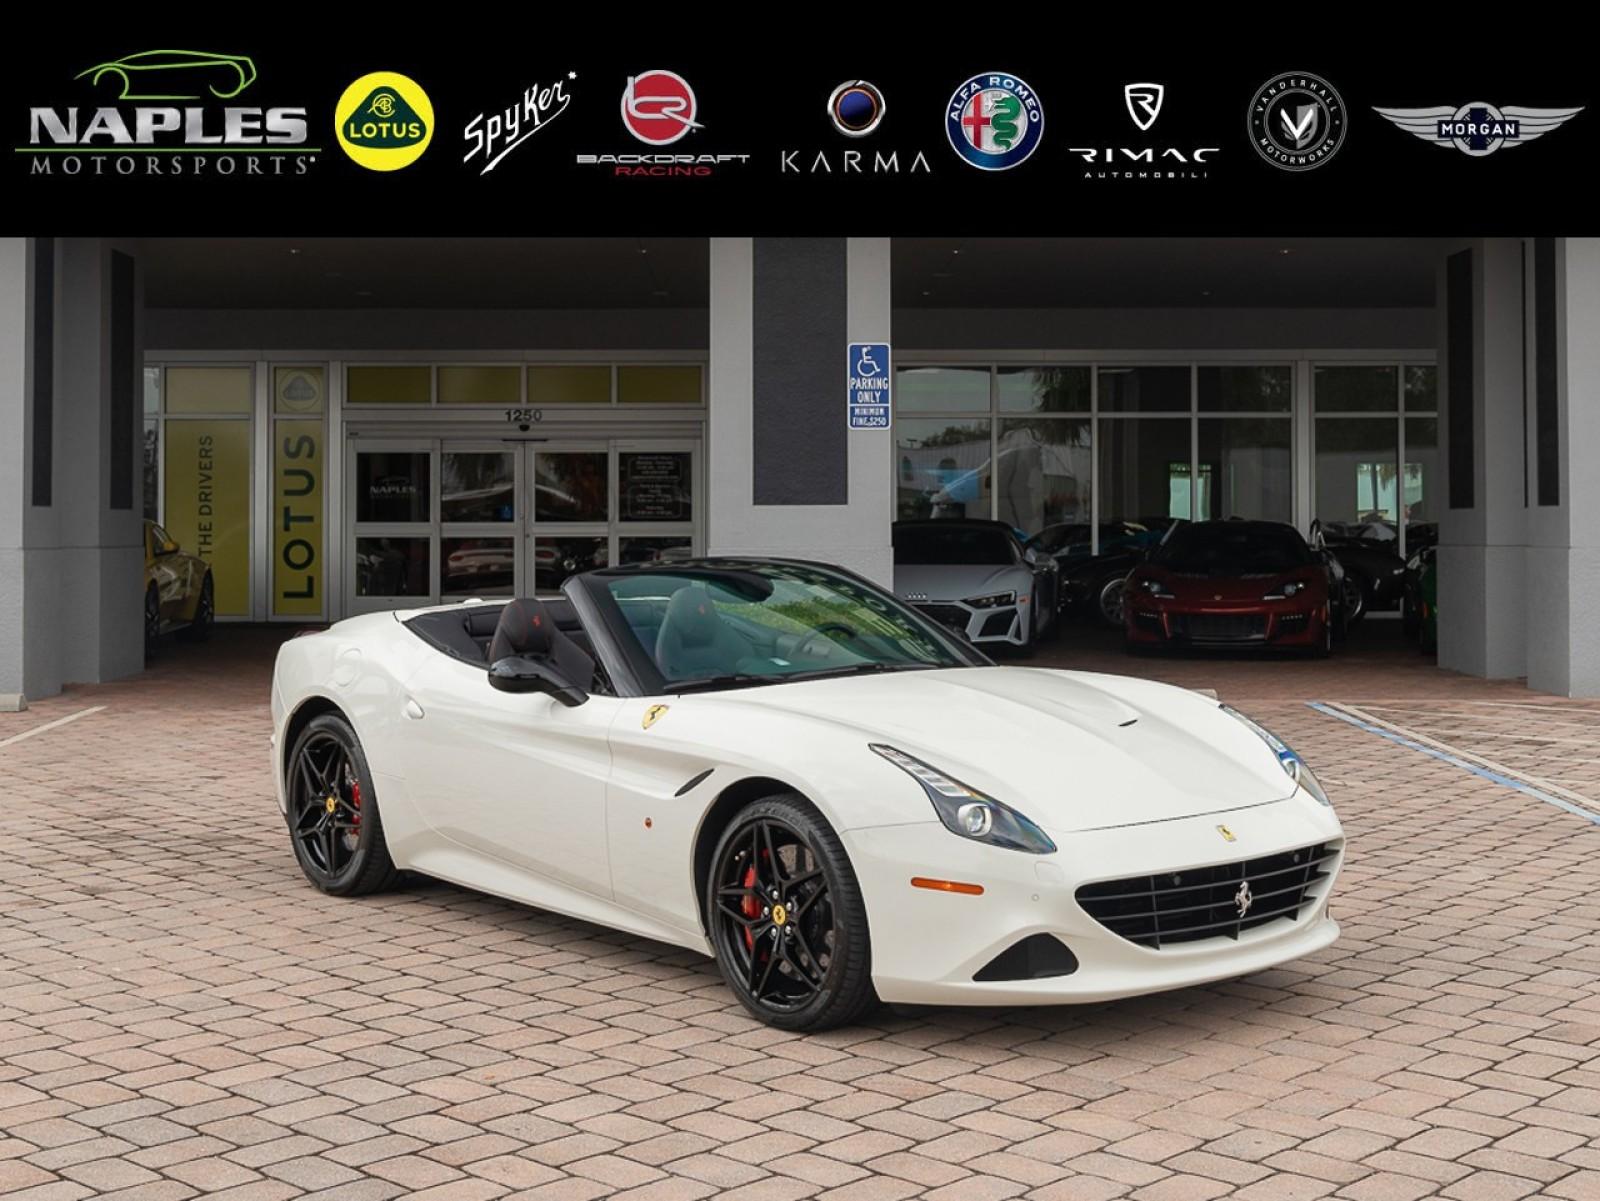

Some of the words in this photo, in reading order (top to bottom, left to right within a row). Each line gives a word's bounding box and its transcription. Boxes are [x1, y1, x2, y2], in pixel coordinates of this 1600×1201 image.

[849, 377, 889, 390] PARKING
[857, 391, 881, 403] ONLY
[505, 409, 543, 422] 1250
[198, 435, 213, 516] DRIVERS
[369, 485, 416, 494] NAPLES
[282, 433, 315, 599] LOTUS
[198, 522, 213, 557] THE
